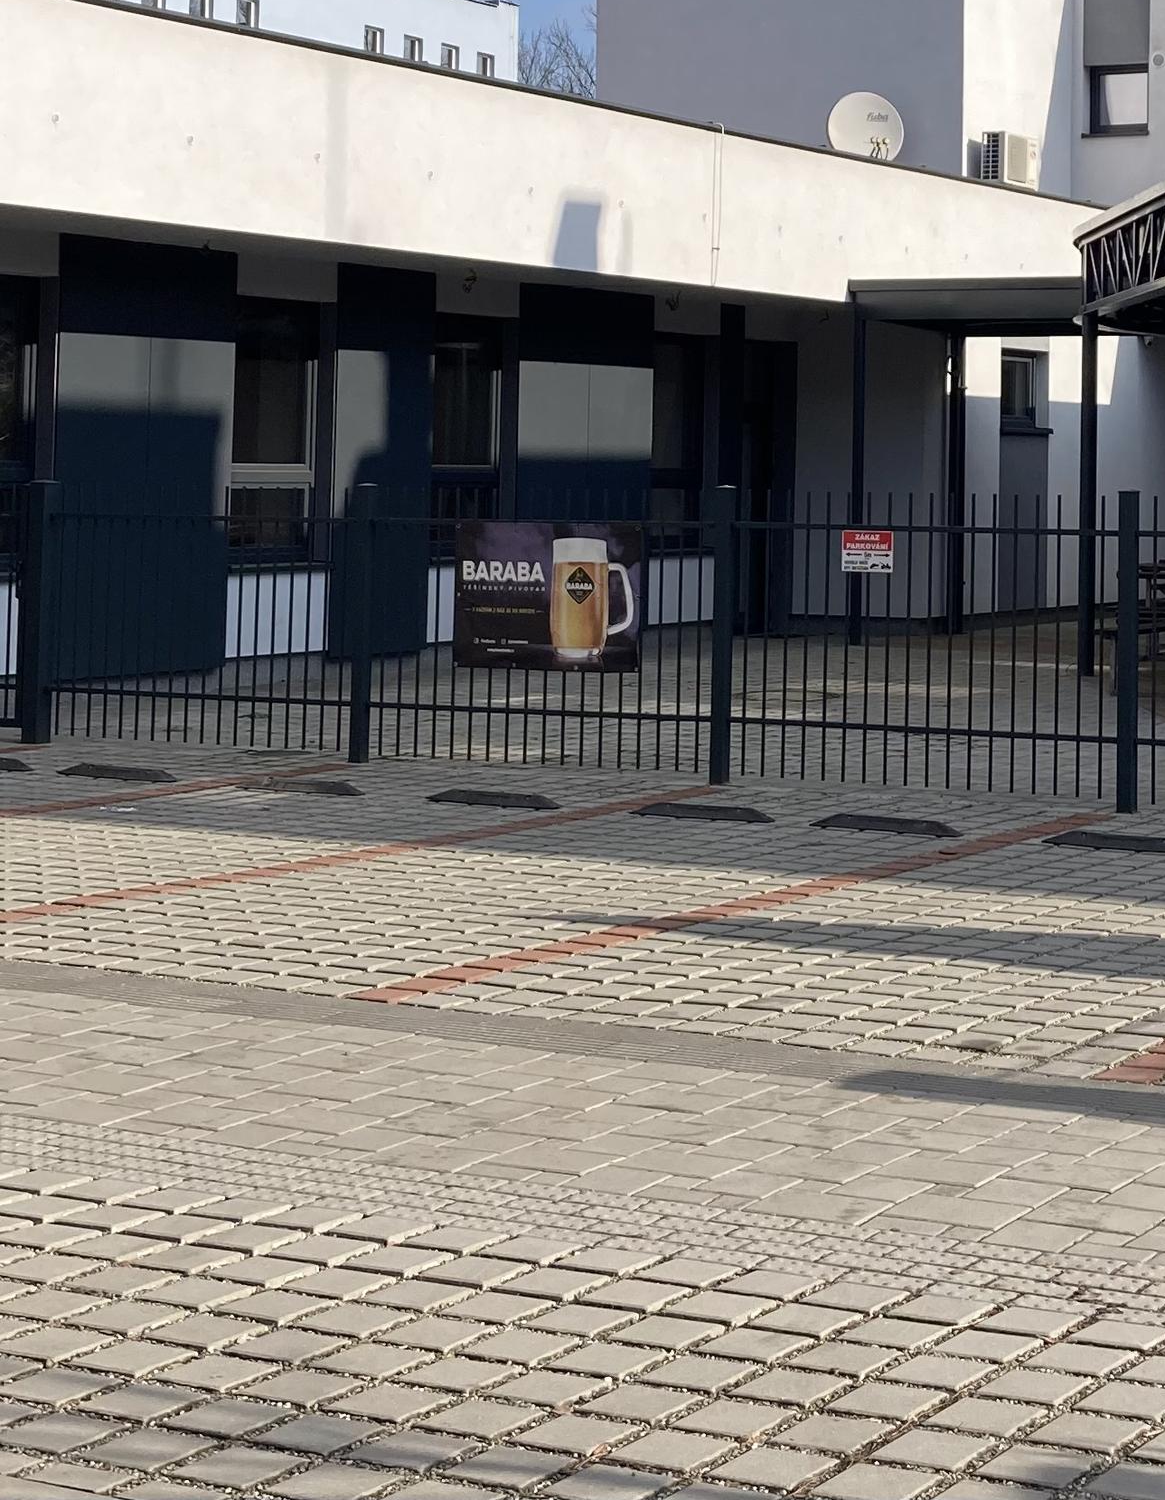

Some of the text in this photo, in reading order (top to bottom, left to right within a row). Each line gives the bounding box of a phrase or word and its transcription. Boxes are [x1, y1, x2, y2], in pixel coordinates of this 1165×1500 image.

[854, 533, 881, 541] ZÁKAZ
[846, 542, 889, 550] PARKOVÁNÍ
[462, 560, 545, 582] BARABA
